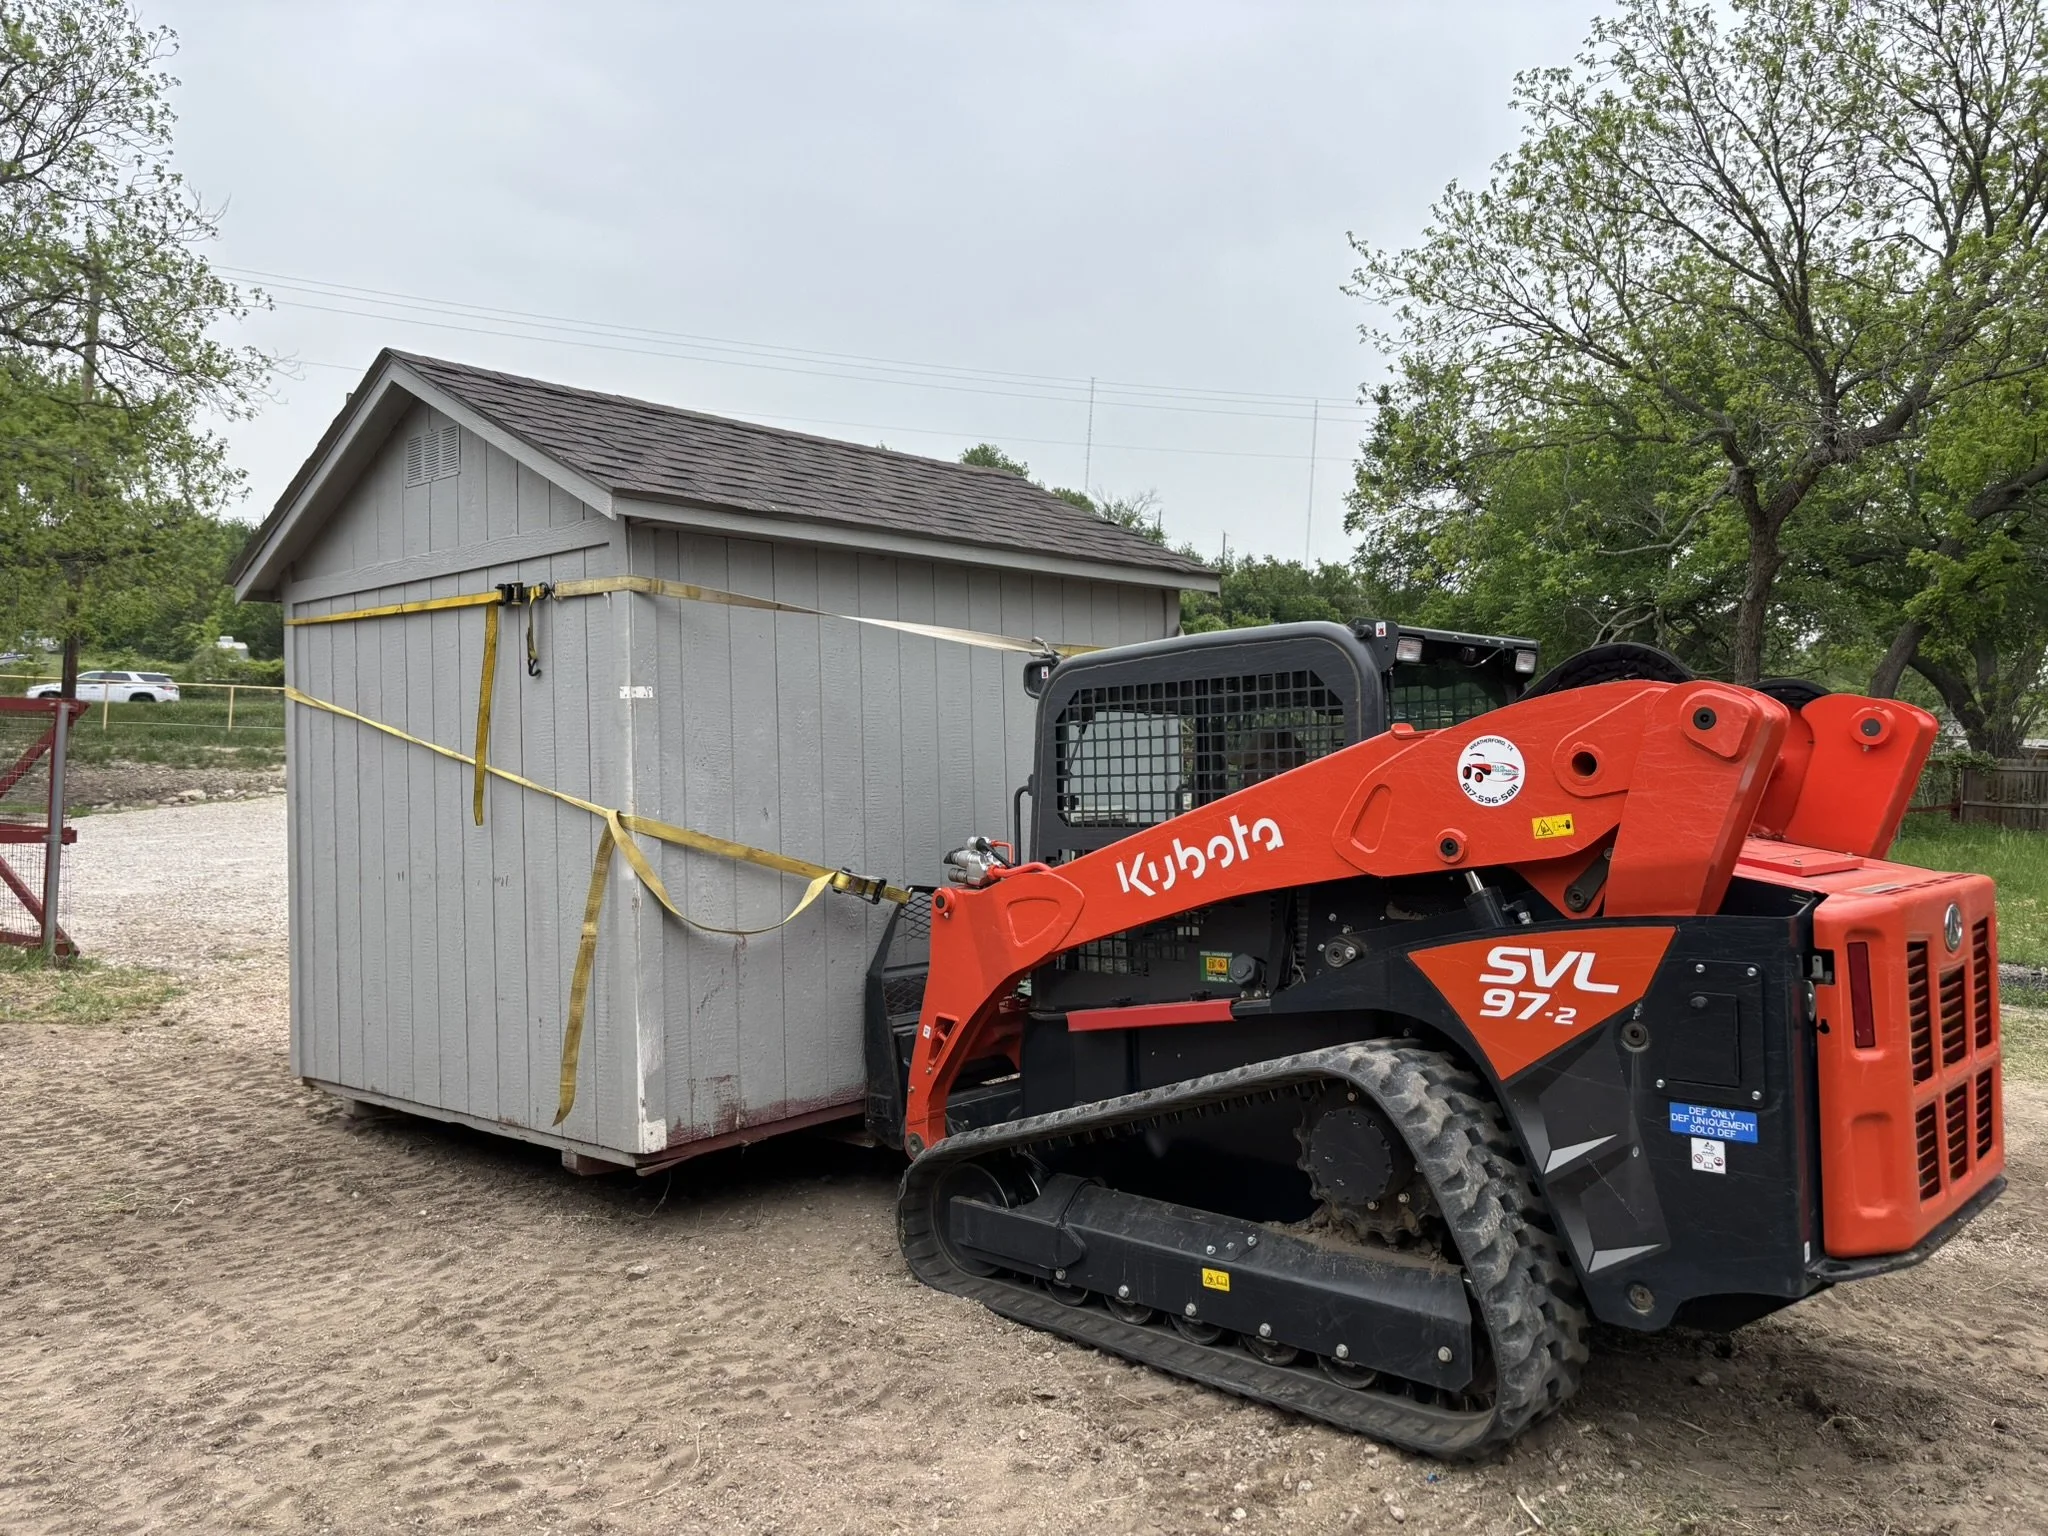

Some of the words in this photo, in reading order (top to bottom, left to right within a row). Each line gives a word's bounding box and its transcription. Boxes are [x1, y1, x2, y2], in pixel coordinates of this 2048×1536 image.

[1462, 782, 1519, 804] 817-596-5811
[1116, 815, 1284, 897] Kubota
[1479, 946, 1620, 994] SVL
[1479, 988, 1577, 1025] 97-2
[1671, 1113, 1689, 1123] DEF
[1692, 1116, 1755, 1132] UNIQUEMENT
[1689, 1106, 1707, 1116] DEF
[1711, 1109, 1736, 1120] ONLY
[1690, 1124, 1715, 1136] SOLO
[1718, 1128, 1737, 1138] DEF
